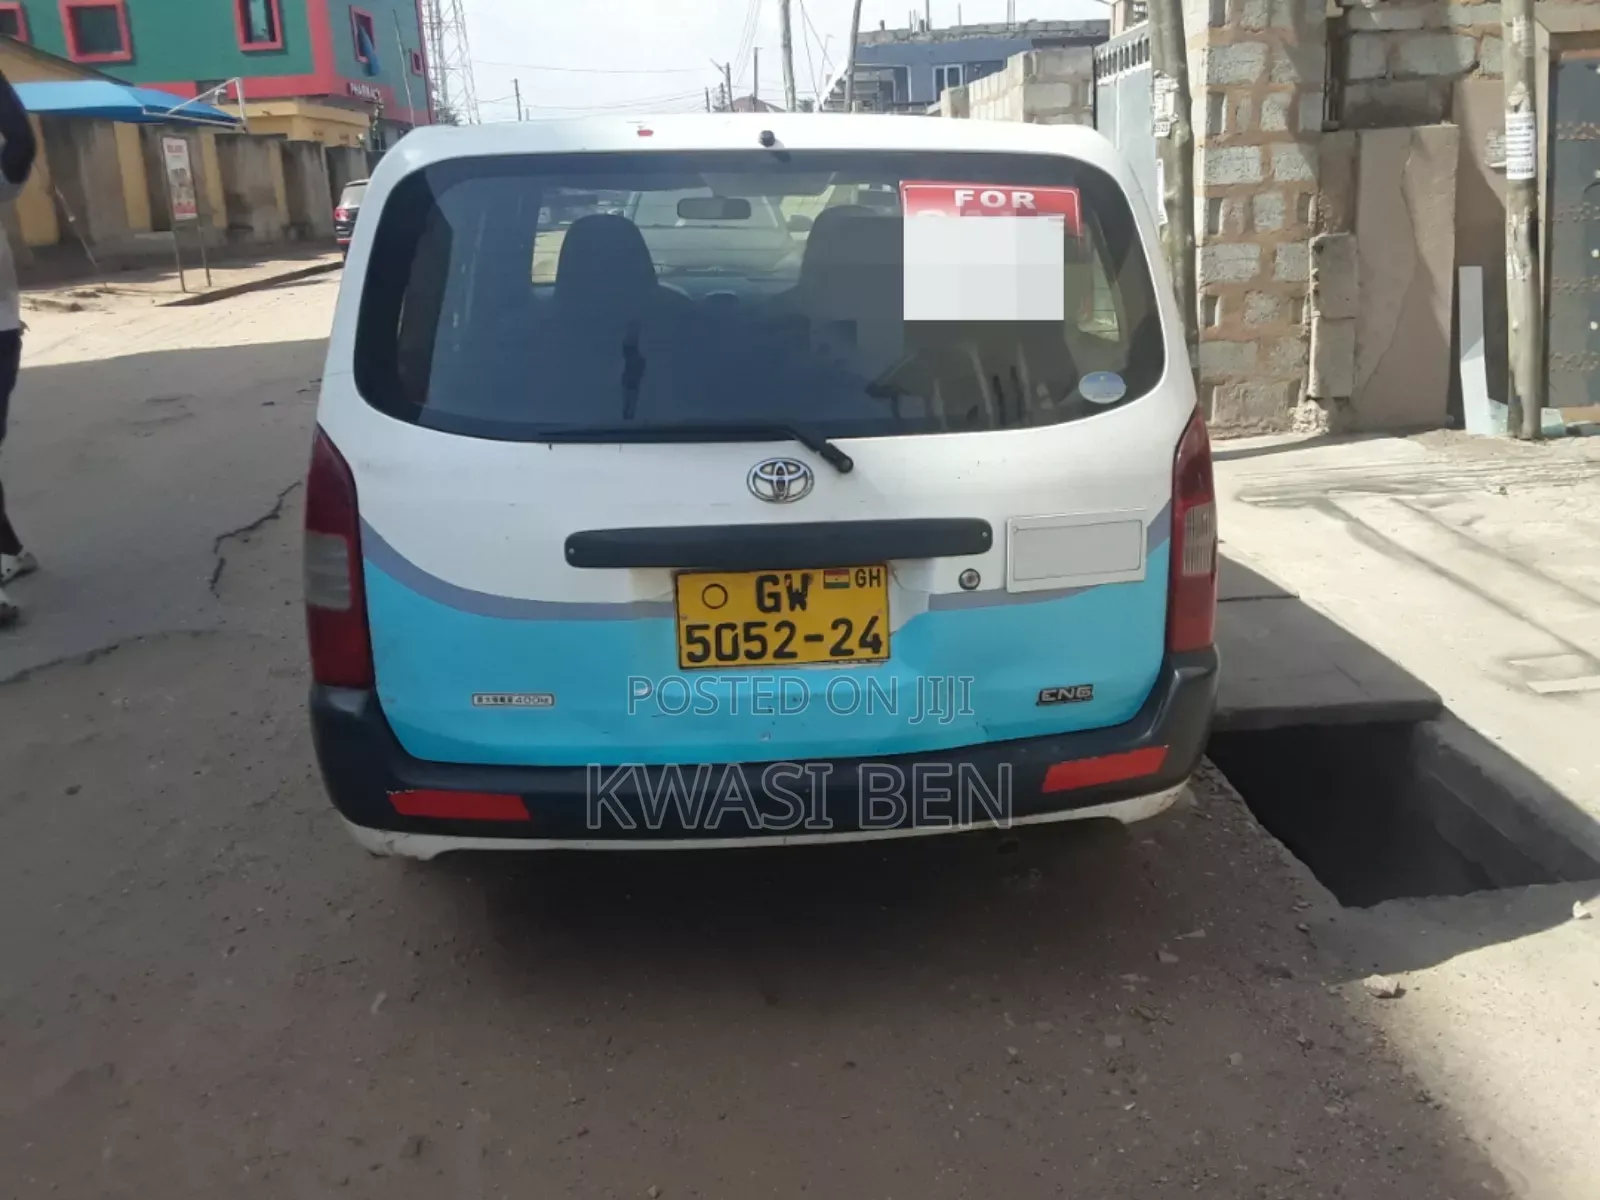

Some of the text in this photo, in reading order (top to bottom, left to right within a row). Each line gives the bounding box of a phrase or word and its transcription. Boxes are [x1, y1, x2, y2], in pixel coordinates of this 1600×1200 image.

[953, 189, 1036, 209] FOR
[755, 573, 809, 613] GW
[854, 568, 881, 588] GH
[685, 615, 883, 663] 5052-24
